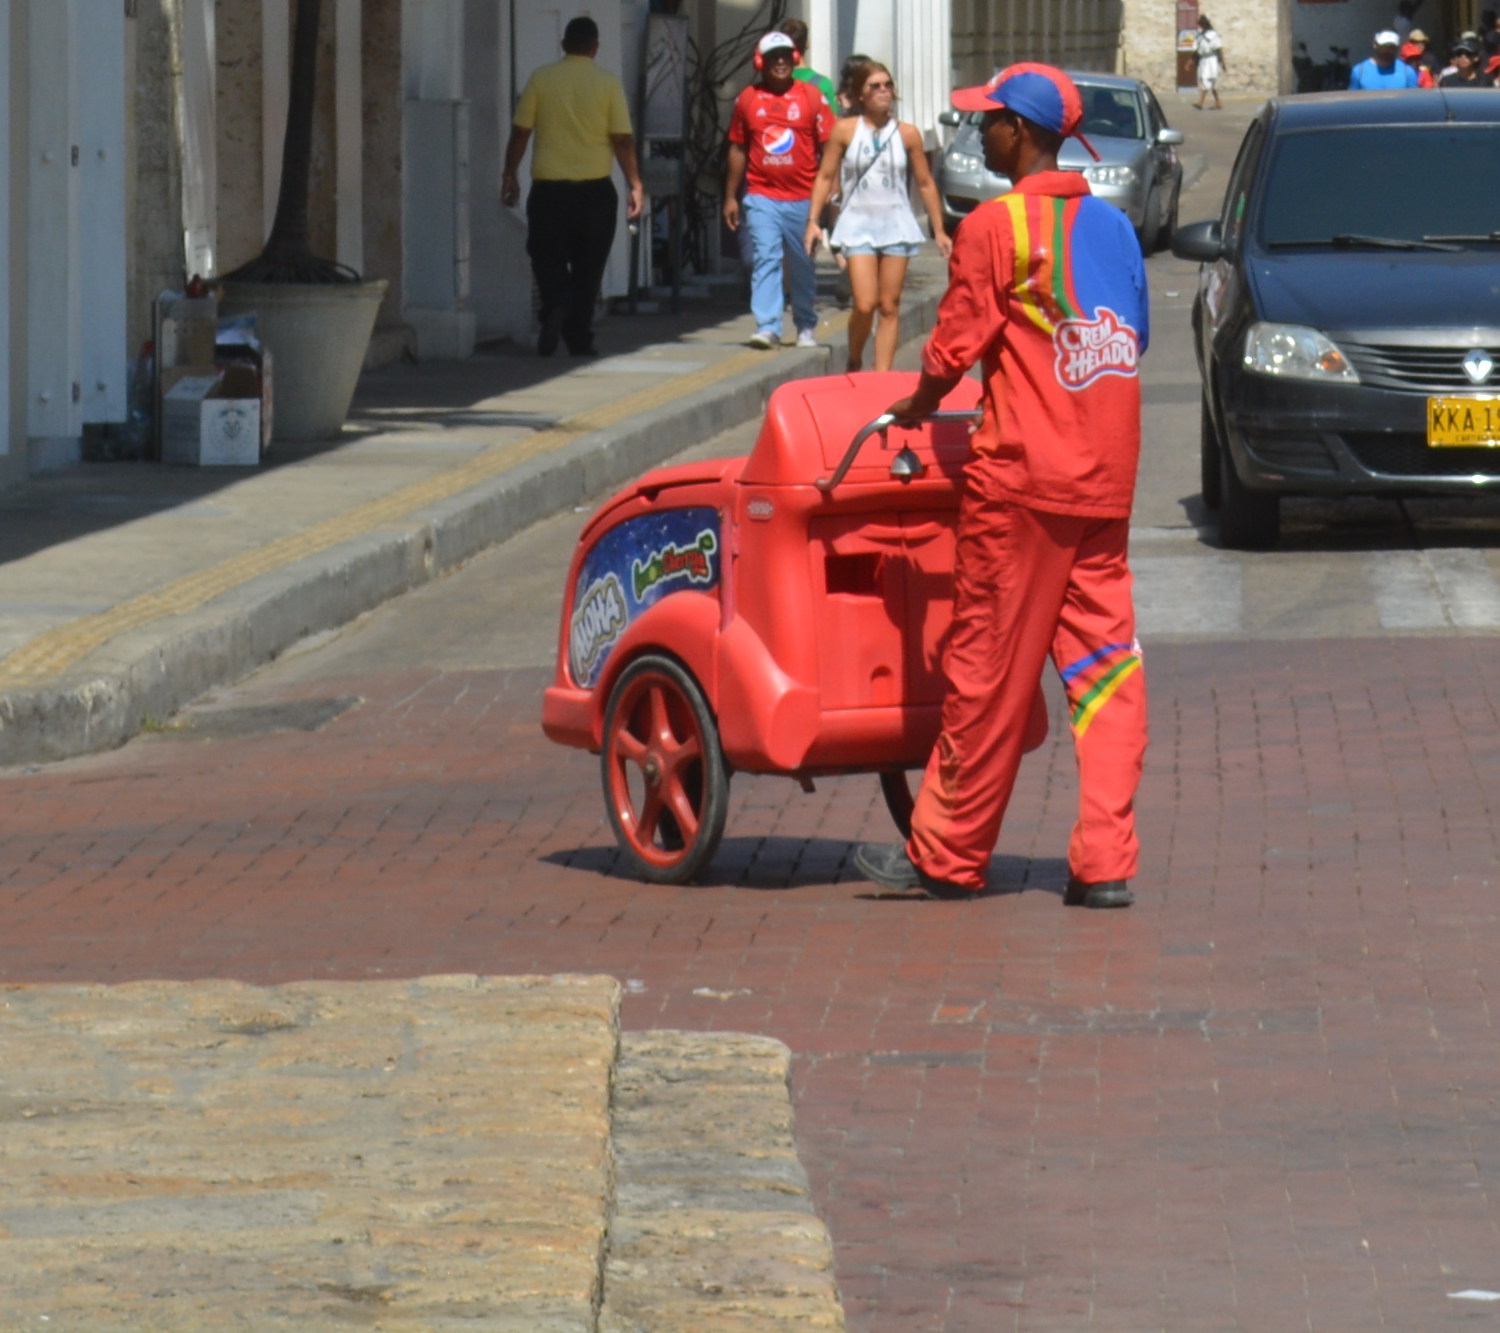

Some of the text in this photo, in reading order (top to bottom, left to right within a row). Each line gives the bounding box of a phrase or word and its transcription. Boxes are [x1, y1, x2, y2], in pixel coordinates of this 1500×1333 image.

[1060, 317, 1112, 350] CREM
[1064, 337, 1136, 381] HELADO
[574, 585, 620, 675] ALOHA
